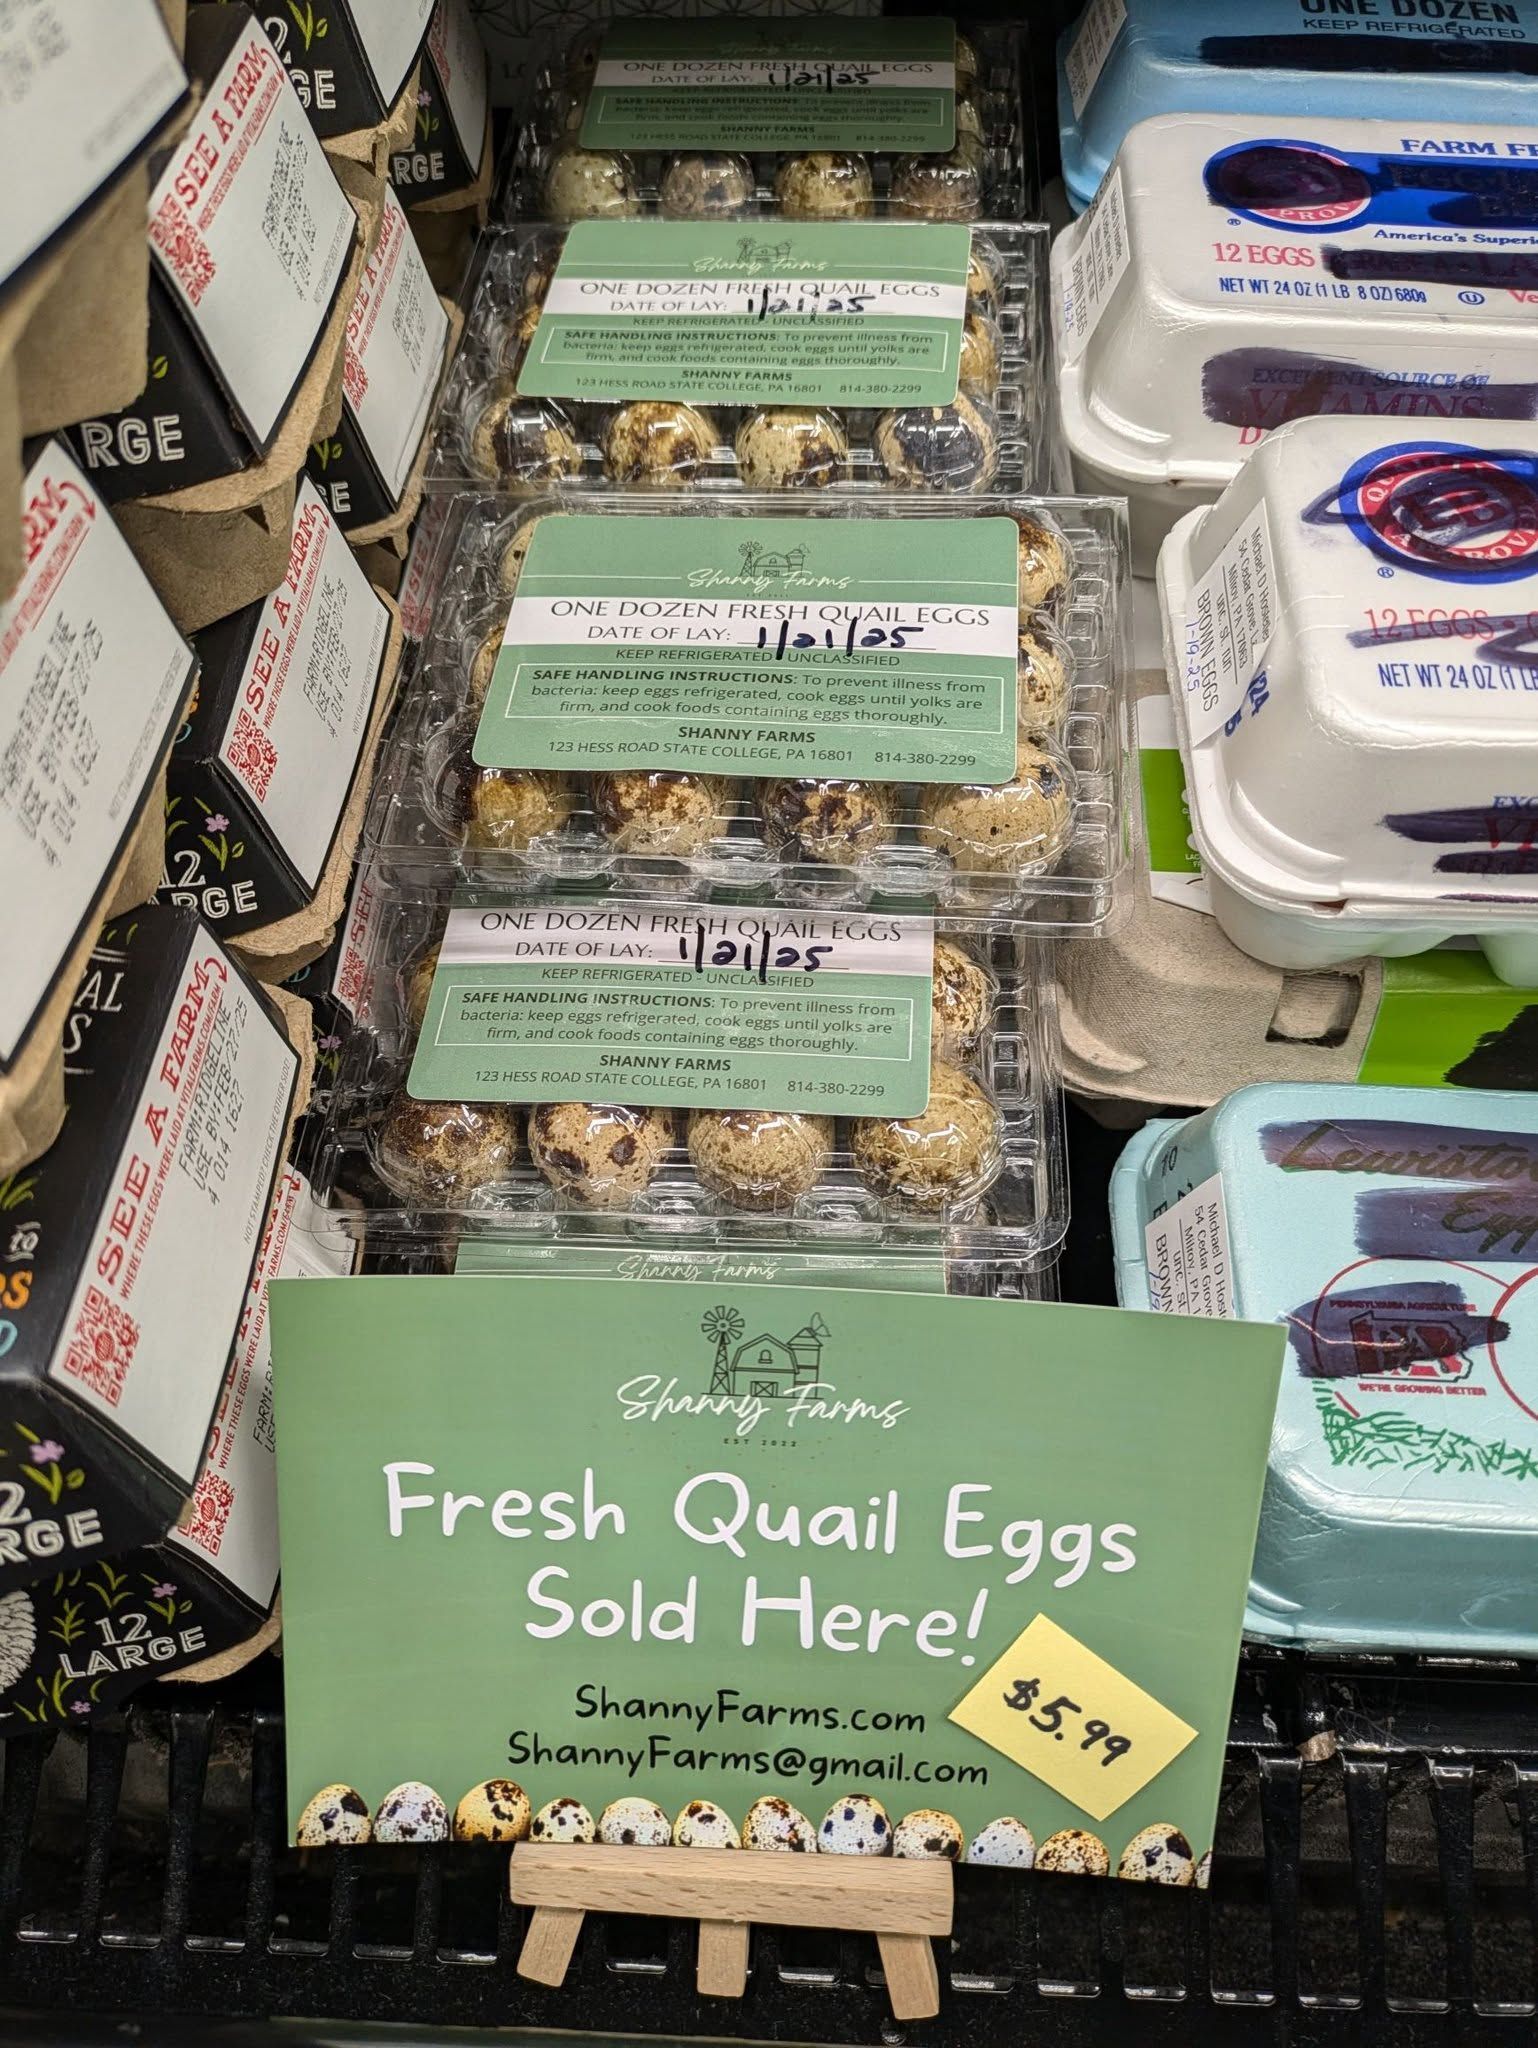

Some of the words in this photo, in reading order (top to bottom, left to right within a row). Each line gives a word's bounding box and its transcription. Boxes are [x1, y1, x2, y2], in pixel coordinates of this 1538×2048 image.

[1394, 0, 1519, 23] DOZEN
[1303, 18, 1359, 30] KEEP
[1366, 20, 1525, 39] REFRIGERATED
[624, 62, 669, 71] ONE
[673, 62, 744, 71] DOZEN
[750, 63, 806, 73] FRESH
[814, 63, 874, 73] QUAIL
[882, 64, 933, 72] EGGS
[1401, 139, 1498, 155] FARM
[1374, 229, 1467, 243] America's
[694, 257, 763, 275] Shanny
[771, 256, 829, 272] Farms
[1213, 243, 1241, 263] 12
[1249, 245, 1315, 267] EGGS
[580, 283, 627, 294] ONE
[637, 284, 717, 294] DOZEN
[726, 283, 790, 296] FRESH
[802, 283, 871, 297] QUAIL
[881, 284, 940, 296] EGGS
[1220, 277, 1244, 292] NET
[1249, 278, 1269, 294] WT
[1274, 280, 1290, 295] 24
[1295, 282, 1312, 296] OZ
[1333, 284, 1350, 298] LB
[1358, 285, 1367, 299] 8
[1395, 287, 1427, 303] 680g
[610, 302, 655, 310] DATE
[662, 302, 684, 310] OF
[691, 302, 727, 310] LAY:
[667, 316, 760, 325] REFRIGERATED
[772, 318, 864, 326] UNCLASSIFIED
[681, 370, 741, 378] SHANNY
[745, 372, 792, 381] FARMS
[282, 503, 317, 593] FARM
[687, 568, 774, 593] Shanny
[779, 570, 854, 589] Farms
[273, 599, 293, 629] A
[552, 601, 609, 616] ONE
[619, 602, 718, 617] DOZEN
[728, 604, 807, 622] FRESH
[819, 605, 906, 624] QUAIL
[917, 608, 989, 625] EGGS
[1196, 589, 1214, 660] BROWN
[1364, 608, 1400, 639] 12
[1407, 609, 1494, 641] EGGS
[588, 626, 641, 638] DATE
[649, 628, 677, 639] OF
[682, 628, 731, 640] LAY:
[757, 616, 924, 660] 1/21/25
[616, 650, 655, 658] KEEP
[659, 650, 773, 661] REFRIGERATED
[787, 652, 900, 667] UNCLASSIFIED
[1186, 621, 1200, 691] 1-19-25
[244, 628, 285, 715] SEE
[533, 670, 572, 679] SAFE
[576, 670, 664, 680] HANDLING
[670, 671, 798, 684] INSTRUCTIONS:
[802, 675, 821, 685] To
[825, 678, 887, 688] prevent
[892, 678, 942, 690] illness
[946, 681, 985, 692] from
[1378, 663, 1409, 687] NET
[1415, 665, 1441, 688] WT
[1446, 666, 1467, 689] 24
[1472, 667, 1497, 690] OZ
[532, 685, 598, 695] bacteria:
[602, 686, 640, 698] keep
[644, 688, 679, 698] eggs
[684, 687, 784, 701] refrigerated,
[787, 691, 824, 702] cook
[829, 694, 865, 705] eggs
[870, 695, 905, 704] until
[910, 696, 952, 708] yolks
[956, 700, 982, 709] are
[1201, 660, 1217, 712] EGGS
[560, 701, 595, 712] firm,
[600, 701, 630, 711] and
[634, 702, 671, 712] cook
[676, 702, 720, 714] foods
[725, 705, 809, 720] containing
[813, 710, 850, 722] eggs
[854, 710, 947, 726] thoroughly.
[678, 727, 752, 740] SHANNY
[757, 730, 815, 742] FARMS
[549, 742, 573, 752] 123
[578, 742, 614, 752] HESS
[618, 742, 659, 752] ROAD
[664, 743, 707, 755] STATE
[710, 746, 782, 760] COLLEGE,
[787, 749, 805, 759] PA
[810, 750, 852, 760] 16801
[875, 752, 976, 766] 814-380-2299
[481, 913, 538, 930] ONE
[546, 913, 641, 930] DOZEN
[651, 917, 726, 937] FRESH
[738, 919, 821, 939] QUAIL
[832, 919, 900, 941] EGGS
[515, 942, 568, 955] DATE
[574, 943, 603, 956] OF
[607, 944, 653, 958] LAY:
[679, 928, 833, 985] 1/21/25
[542, 968, 578, 978] KEEP
[582, 969, 692, 982] REFRIGERATED
[707, 972, 813, 988] UNCLASSIFIED
[600, 1055, 670, 1068] SHANNY
[675, 1058, 730, 1070] FARMS
[475, 1071, 498, 1081] 123
[502, 1072, 538, 1082] HESS
[542, 1072, 581, 1082] ROAD
[585, 1073, 627, 1084] STATE
[631, 1075, 698, 1089] COLLEGE,
[703, 1078, 720, 1088] PA
[726, 1078, 766, 1090] 16801
[788, 1081, 884, 1096] 814-380-2299
[95, 1152, 154, 1286] SEE
[140, 1104, 169, 1147] A
[159, 961, 212, 1092] FARM
[1194, 1206, 1203, 1224] 54
[1207, 1203, 1223, 1258] Michael
[1196, 1229, 1209, 1270] Cedar
[1214, 1263, 1224, 1275] D
[1200, 1275, 1212, 1317] Grove
[1394, 1385, 1444, 1395] GROWING
[1446, 1386, 1487, 1397] BETTER
[617, 1375, 771, 1436] Shanny
[784, 1383, 911, 1428] Farms
[383, 1462, 626, 1540] Fresh
[674, 1472, 898, 1558] Quail
[944, 1484, 1137, 1588] Eggs
[525, 1566, 699, 1643] Sold
[742, 1576, 988, 1666] Here!
[95, 1612, 153, 1647] 12
[59, 1626, 207, 1679] LARGE
[574, 1683, 926, 1735] ShannyFarms.com
[1003, 1677, 1134, 1770] $5.99
[507, 1731, 990, 1790] ShannyFarms@gmail.com
